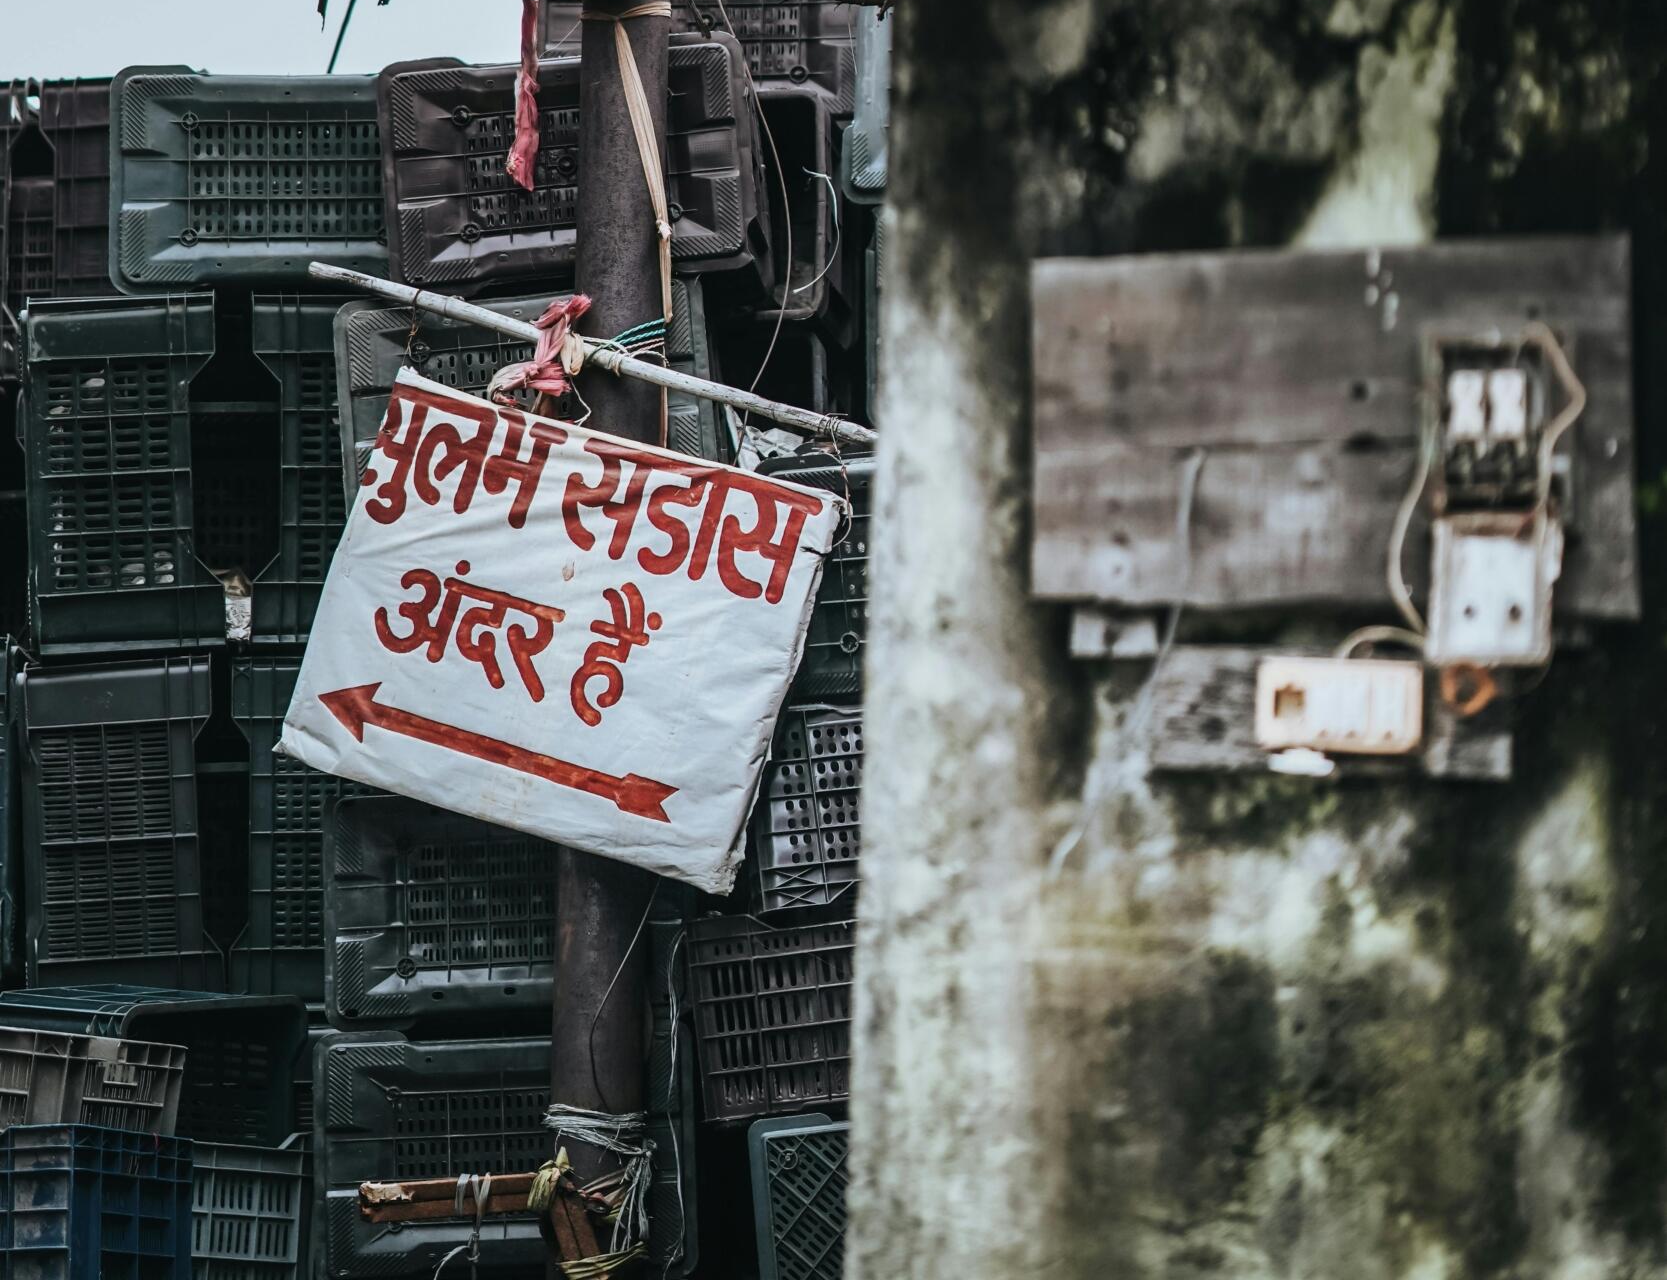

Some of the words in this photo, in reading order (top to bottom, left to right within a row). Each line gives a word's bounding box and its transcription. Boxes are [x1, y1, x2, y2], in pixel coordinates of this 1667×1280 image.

[562, 437, 822, 604] सडास
[375, 560, 566, 702] अंदर
[571, 582, 663, 726] हैं
